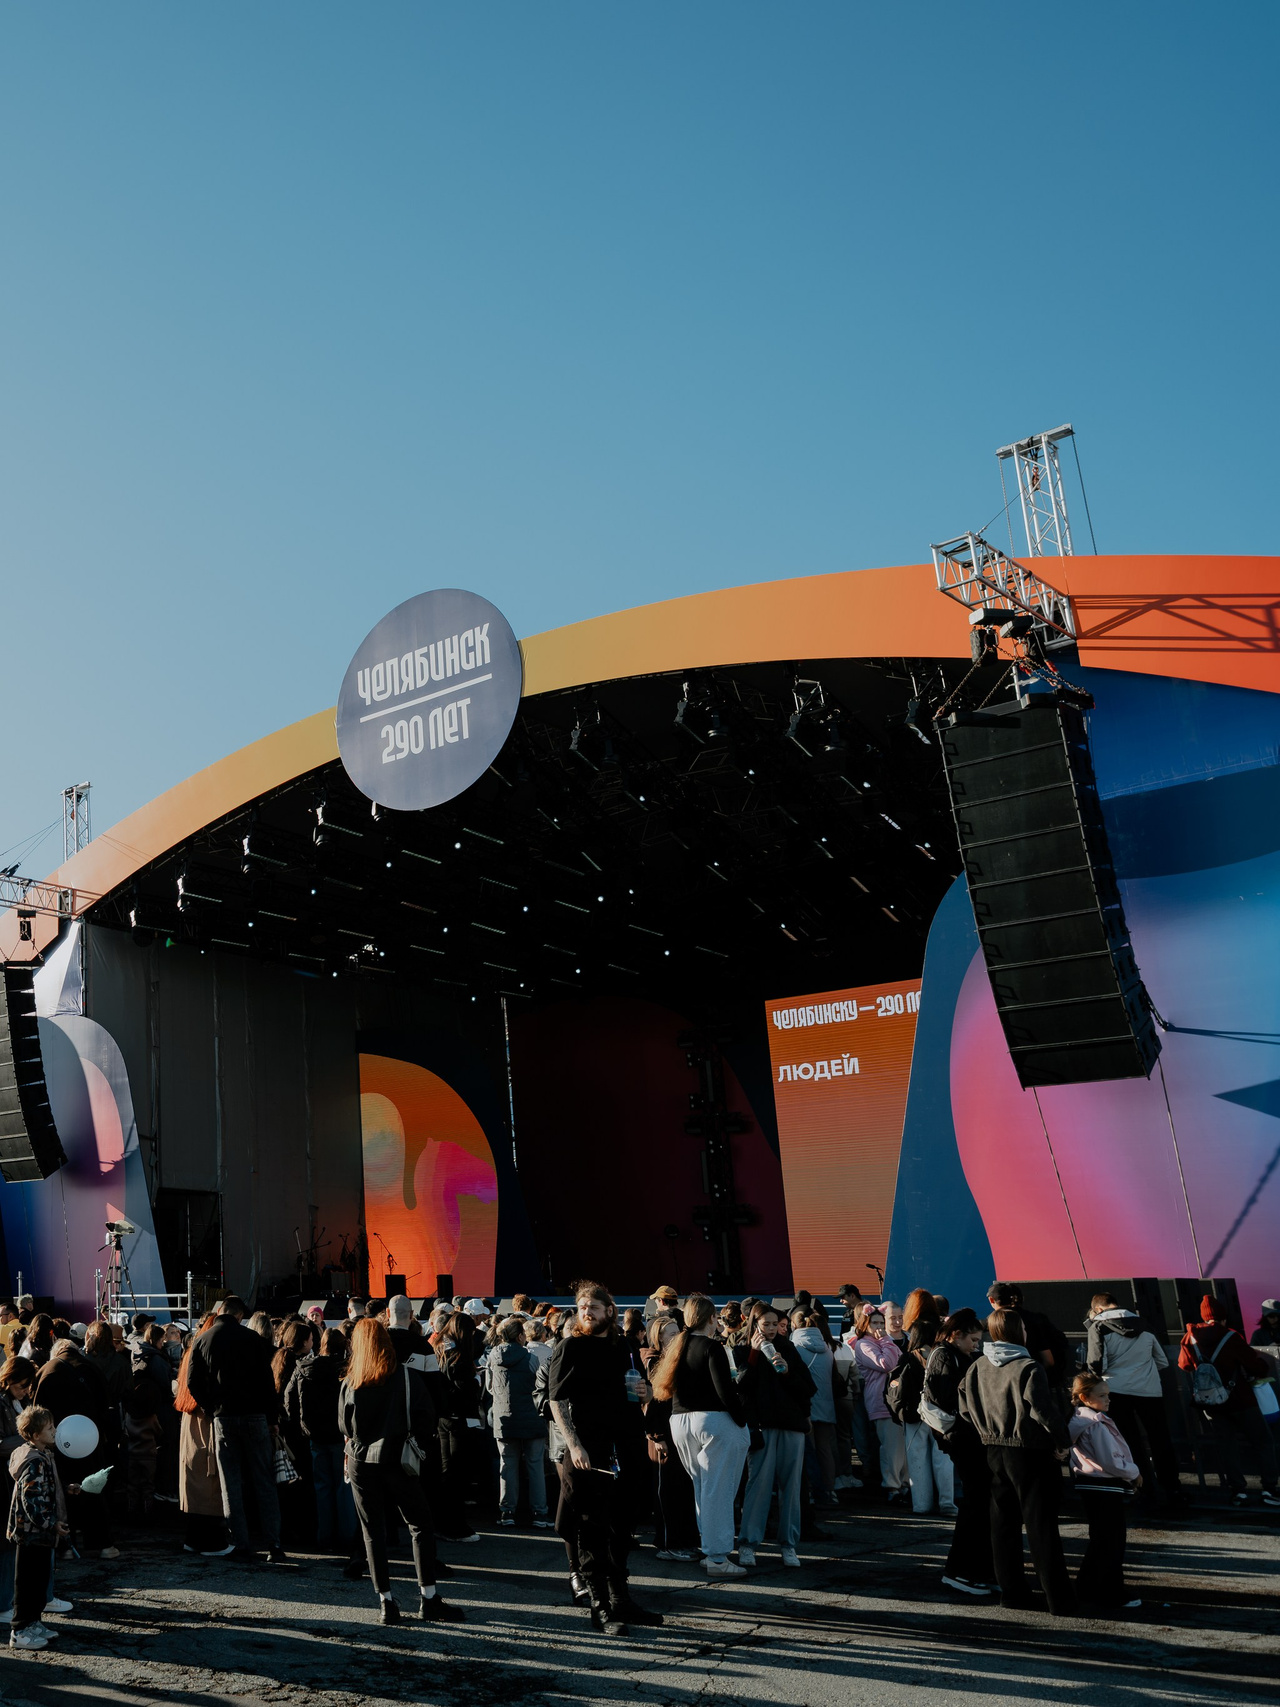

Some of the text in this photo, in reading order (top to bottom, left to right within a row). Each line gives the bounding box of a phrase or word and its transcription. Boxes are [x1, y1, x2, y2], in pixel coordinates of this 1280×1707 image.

[380, 714, 424, 765] 290
[876, 993, 904, 1017] 290
[778, 1053, 860, 1083] ЛЮДЕЙ
